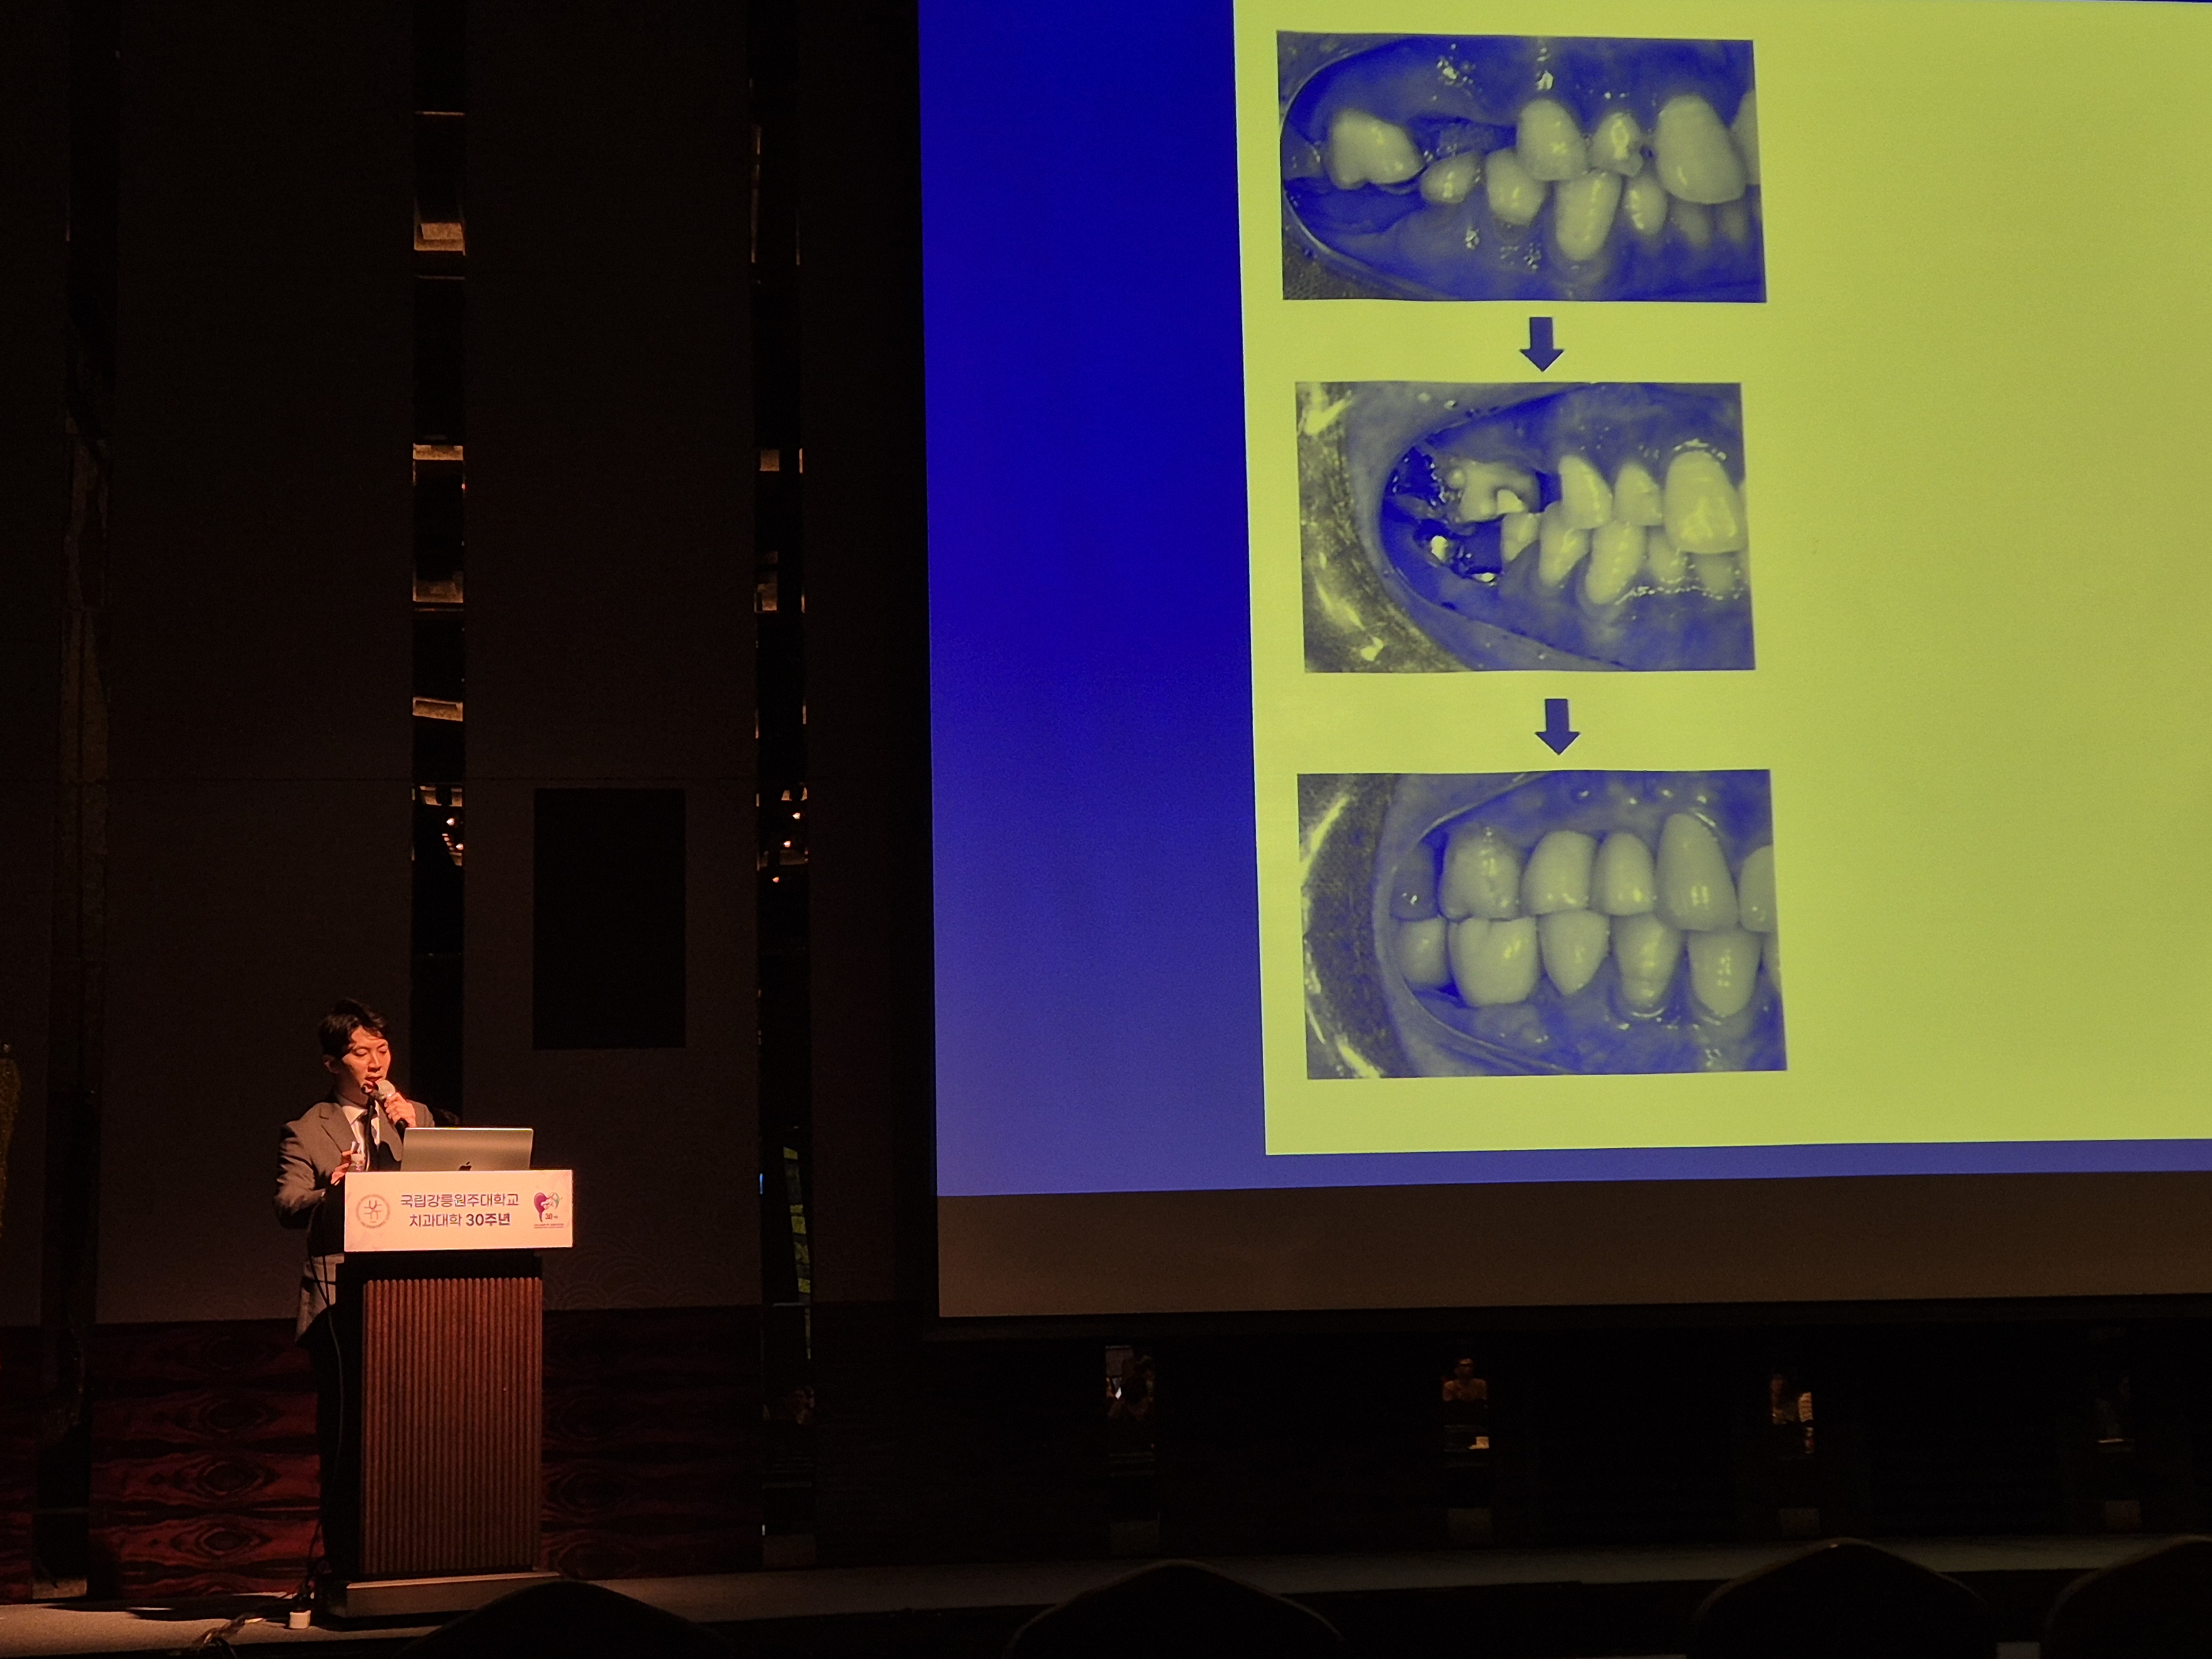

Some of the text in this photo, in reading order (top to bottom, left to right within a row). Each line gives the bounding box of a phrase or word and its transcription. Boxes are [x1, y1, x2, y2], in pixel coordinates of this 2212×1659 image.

[400, 1193, 519, 1208] 국립강릉원주대학교
[409, 1213, 510, 1227] 치과대학 30주년
